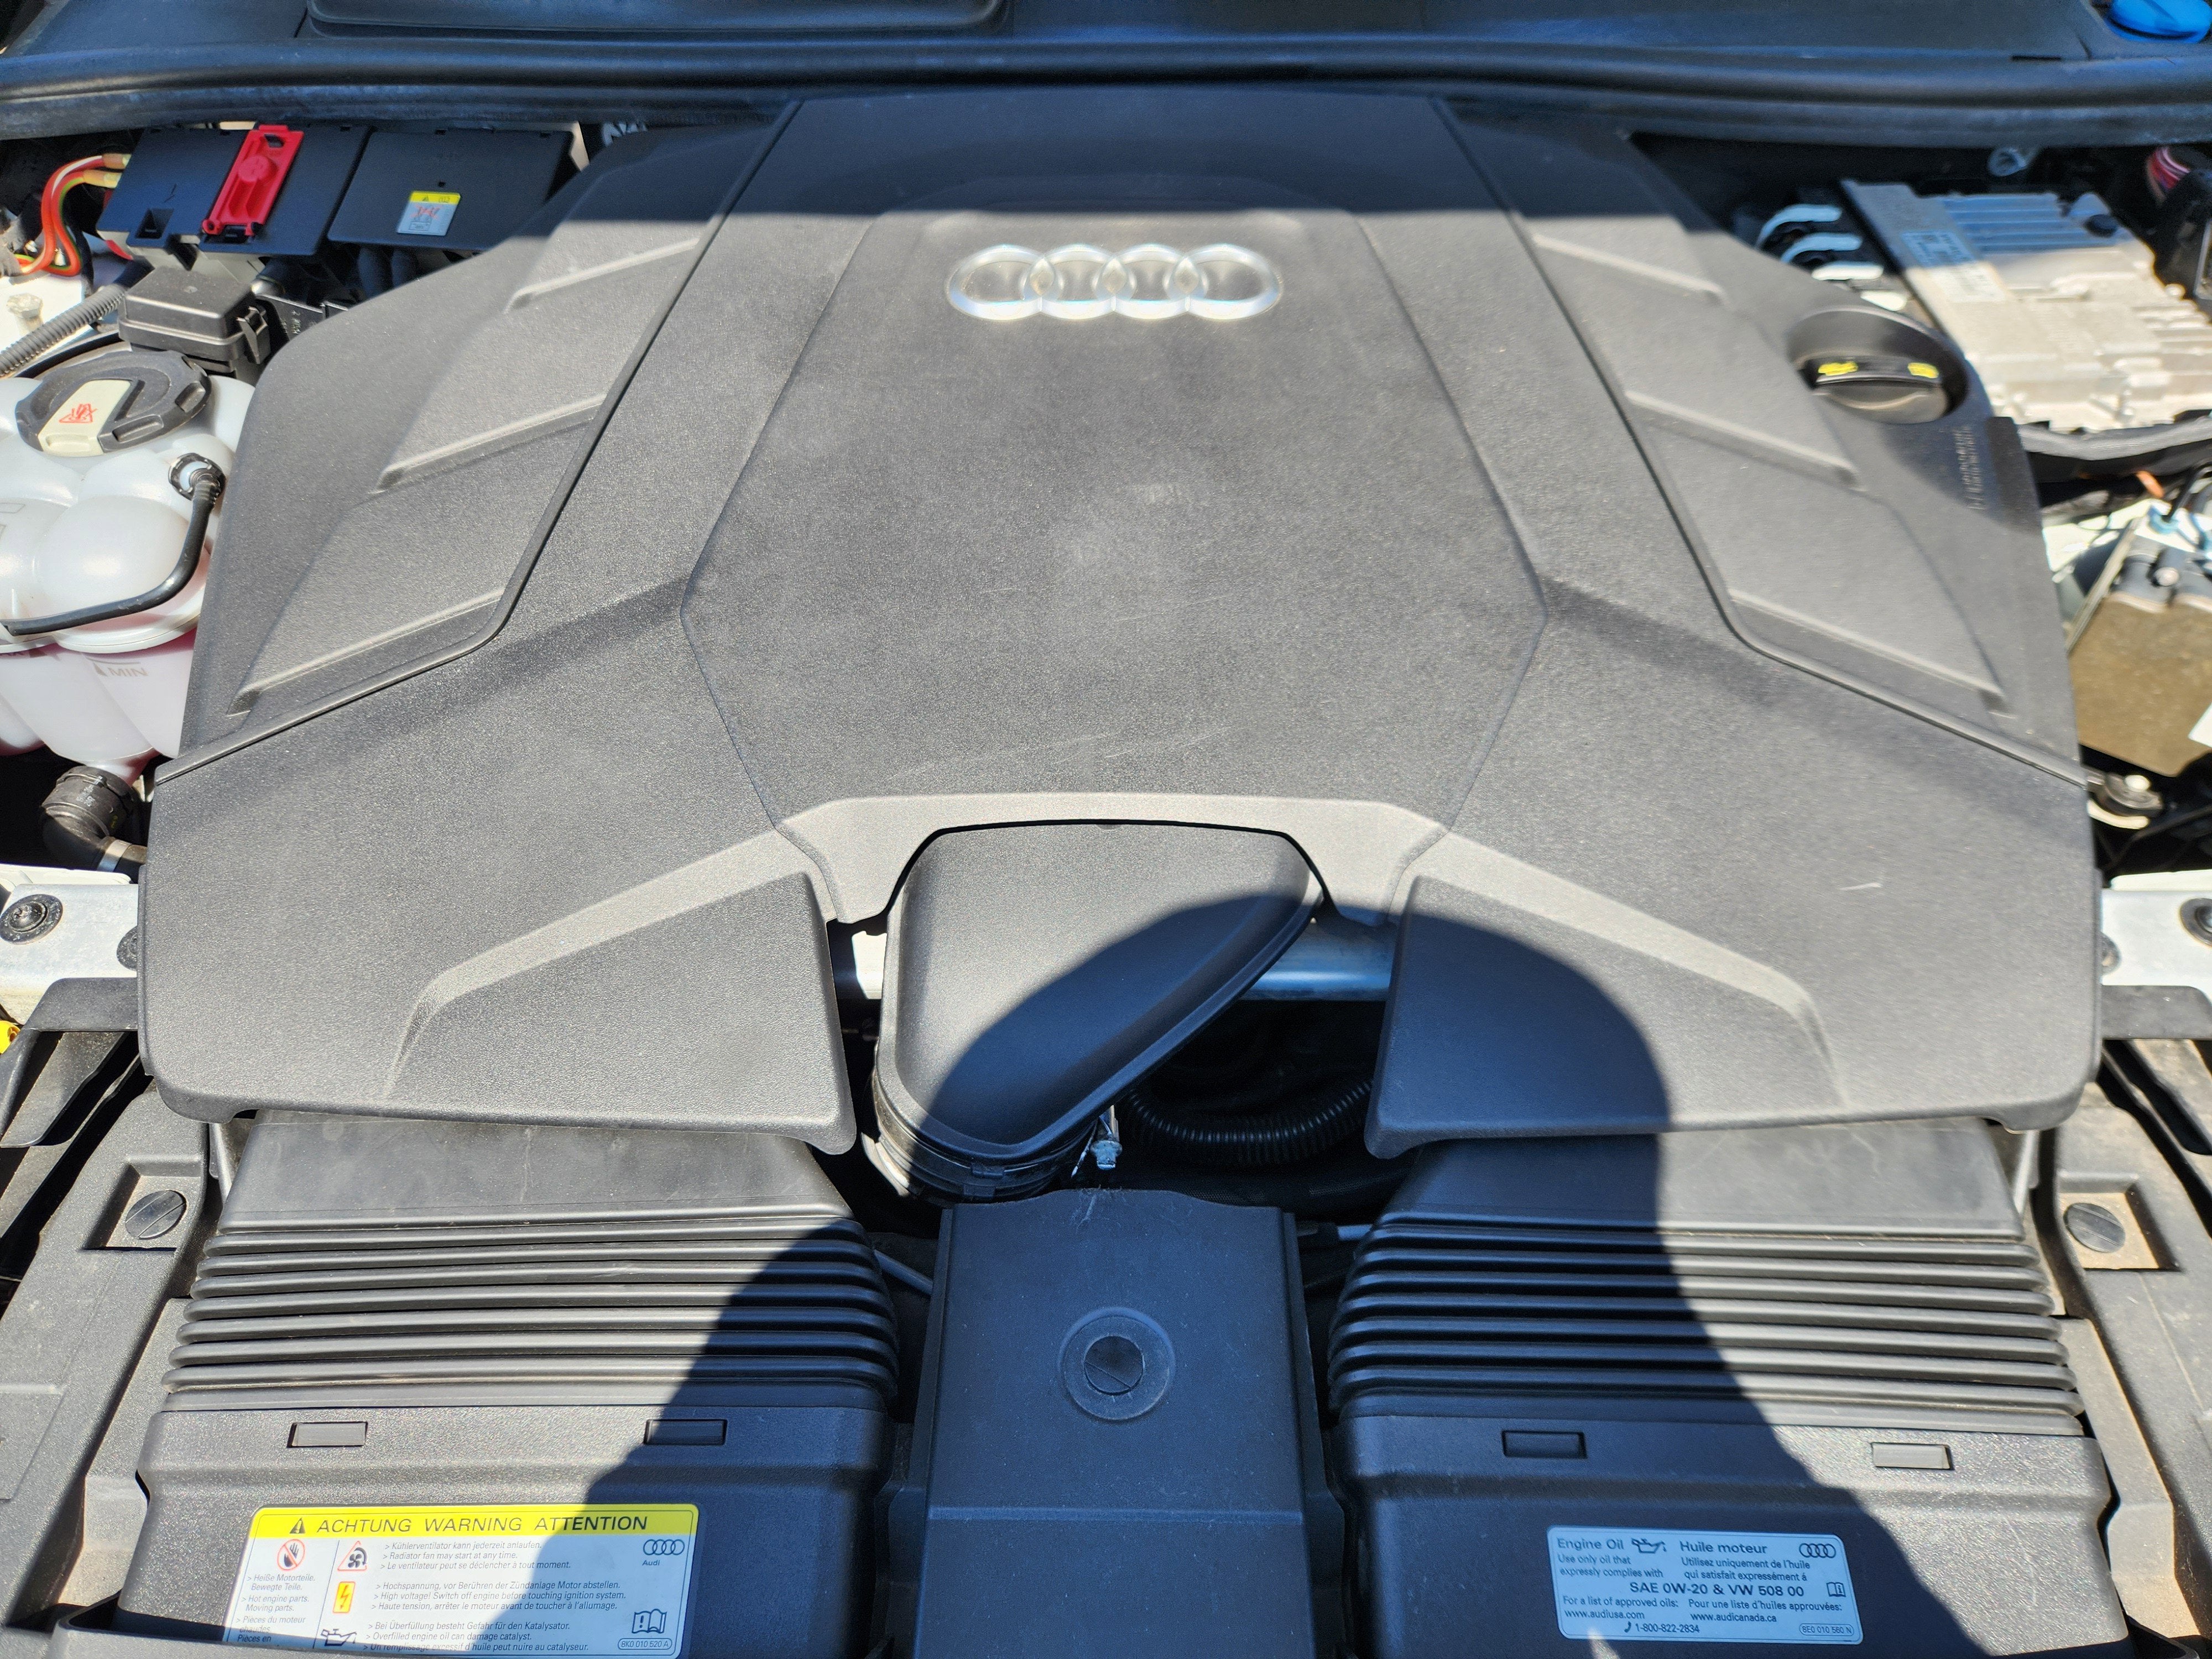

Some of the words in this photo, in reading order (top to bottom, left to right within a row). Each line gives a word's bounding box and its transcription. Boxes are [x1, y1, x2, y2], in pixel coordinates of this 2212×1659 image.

[107, 667, 148, 677] MIN
[317, 1518, 412, 1532] ACHTUNG
[425, 1517, 522, 1531] WARNING
[534, 1516, 648, 1531] ATTENTION
[472, 1541, 505, 1551] jederzeit
[1557, 1538, 1602, 1551] Engine
[1606, 1538, 1624, 1550] Oil
[1679, 1541, 1714, 1552] Huile
[1717, 1543, 1767, 1554] moteur
[437, 1553, 453, 1561] may
[1557, 1553, 1575, 1563] Use
[1578, 1553, 1598, 1565] only
[1600, 1554, 1611, 1564] oil
[1613, 1554, 1632, 1564] that
[440, 1562, 457, 1571] peut
[1681, 1557, 1714, 1567] Utilisez
[1715, 1558, 1769, 1569] uniquement
[1771, 1559, 1781, 1568] de
[276, 1573, 316, 1582] Motorteile.
[1560, 1567, 1600, 1578] expressly
[1603, 1567, 1642, 1579] complies
[1644, 1567, 1664, 1578] with
[1684, 1569, 1699, 1580] qui
[1700, 1570, 1735, 1579] satisfait
[1738, 1571, 1800, 1582] expressément
[251, 1583, 282, 1592] Bewegte
[383, 1582, 441, 1591] Hochspannung,
[495, 1581, 510, 1589] der
[510, 1580, 555, 1590] Zündanlage
[583, 1580, 620, 1589] abstellen.
[1630, 1581, 1659, 1594] SAE
[1662, 1582, 1708, 1595] 0W-20
[1713, 1584, 1725, 1595] &
[1728, 1584, 1754, 1595] VW
[1759, 1585, 1784, 1597] 508
[1787, 1585, 1804, 1597] 00
[263, 1595, 288, 1604] engine
[289, 1595, 309, 1604] parts.
[380, 1592, 398, 1601] High
[400, 1592, 431, 1601] voltage!
[501, 1591, 526, 1599] before
[528, 1591, 562, 1600] touching
[564, 1591, 594, 1599] ignition
[596, 1592, 626, 1600] system.
[1562, 1595, 1578, 1605] For
[1587, 1596, 1602, 1606] list
[1604, 1596, 1613, 1606] of
[1615, 1598, 1657, 1608] approved
[1660, 1598, 1679, 1608] oils:
[246, 1604, 273, 1613] Moving
[274, 1604, 294, 1613] parts.
[403, 1602, 432, 1610] tension,
[567, 1601, 572, 1609] à
[1688, 1599, 1709, 1609] Pour
[1712, 1601, 1728, 1609] une
[1731, 1599, 1750, 1610] liste
[1790, 1601, 1843, 1612] approuvées:
[1564, 1609, 1645, 1620] www.audiusa.com
[1689, 1612, 1777, 1623] www.audicanada.ca
[375, 1621, 388, 1630] Bei
[389, 1620, 434, 1631] Überfüllung
[467, 1621, 493, 1630] Gefahr
[495, 1621, 505, 1630] für
[508, 1621, 523, 1630] den
[525, 1621, 570, 1631] Katalysator.
[1635, 1623, 1700, 1633] 1-800-822-2834
[373, 1632, 409, 1640] Overfilled
[411, 1633, 437, 1641] engine
[440, 1632, 450, 1640] oil
[467, 1632, 498, 1641] damage
[500, 1632, 532, 1641] catalyst.
[383, 1643, 430, 1652] remplissage
[432, 1642, 464, 1651] excessif
[493, 1644, 510, 1652] peut
[547, 1642, 589, 1652] catalyseur.
